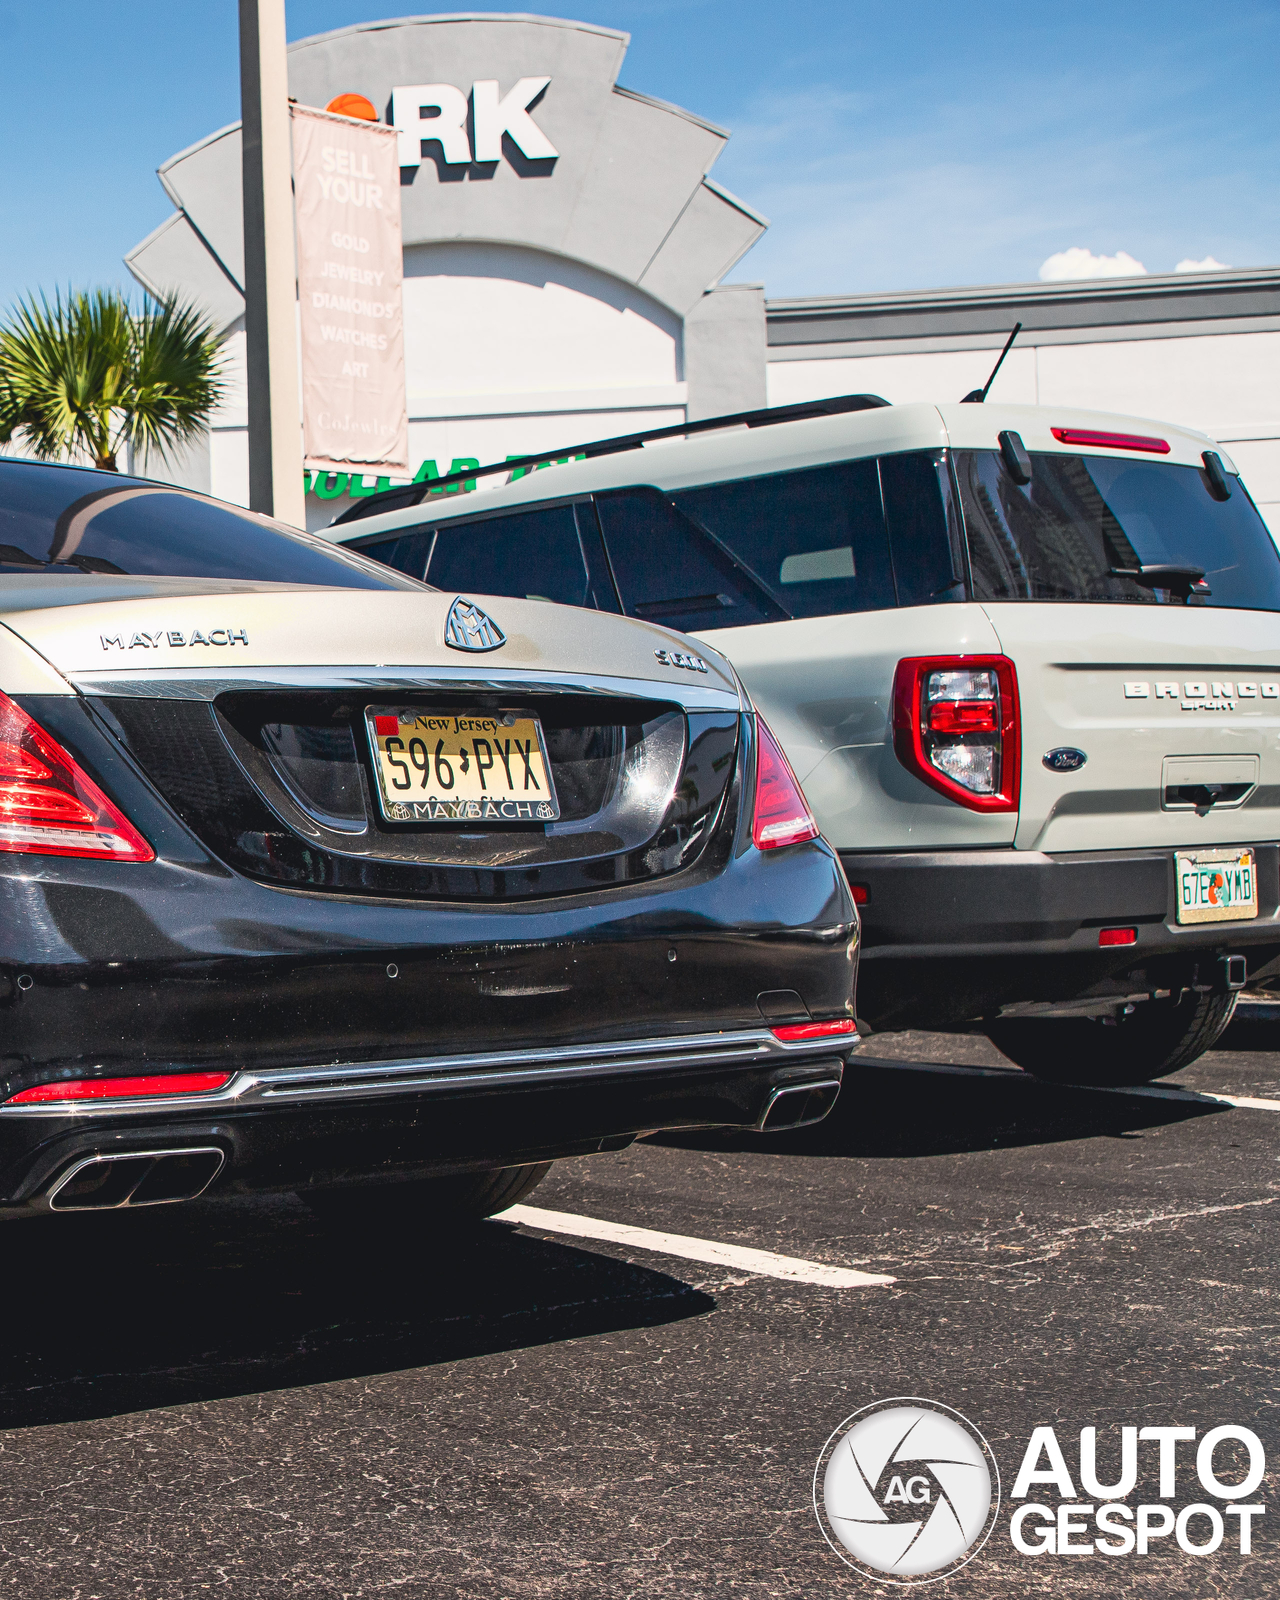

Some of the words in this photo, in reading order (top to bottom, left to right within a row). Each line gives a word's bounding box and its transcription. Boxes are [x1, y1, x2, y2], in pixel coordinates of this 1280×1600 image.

[324, 76, 559, 168] RK
[321, 146, 376, 181] SELL
[315, 172, 383, 210] YOUR
[331, 231, 370, 254] GOLD
[320, 261, 385, 287] JEWELRY
[312, 291, 395, 320] DIAMONDS
[320, 324, 388, 351] WATCHES
[341, 359, 370, 378] ART
[100, 628, 249, 651] MAYBACH
[1123, 681, 1280, 699] BRONCO
[1180, 700, 1239, 711] SPORT
[414, 717, 450, 731] New
[453, 717, 499, 735] Jersey
[413, 802, 533, 818] MAYBACH
